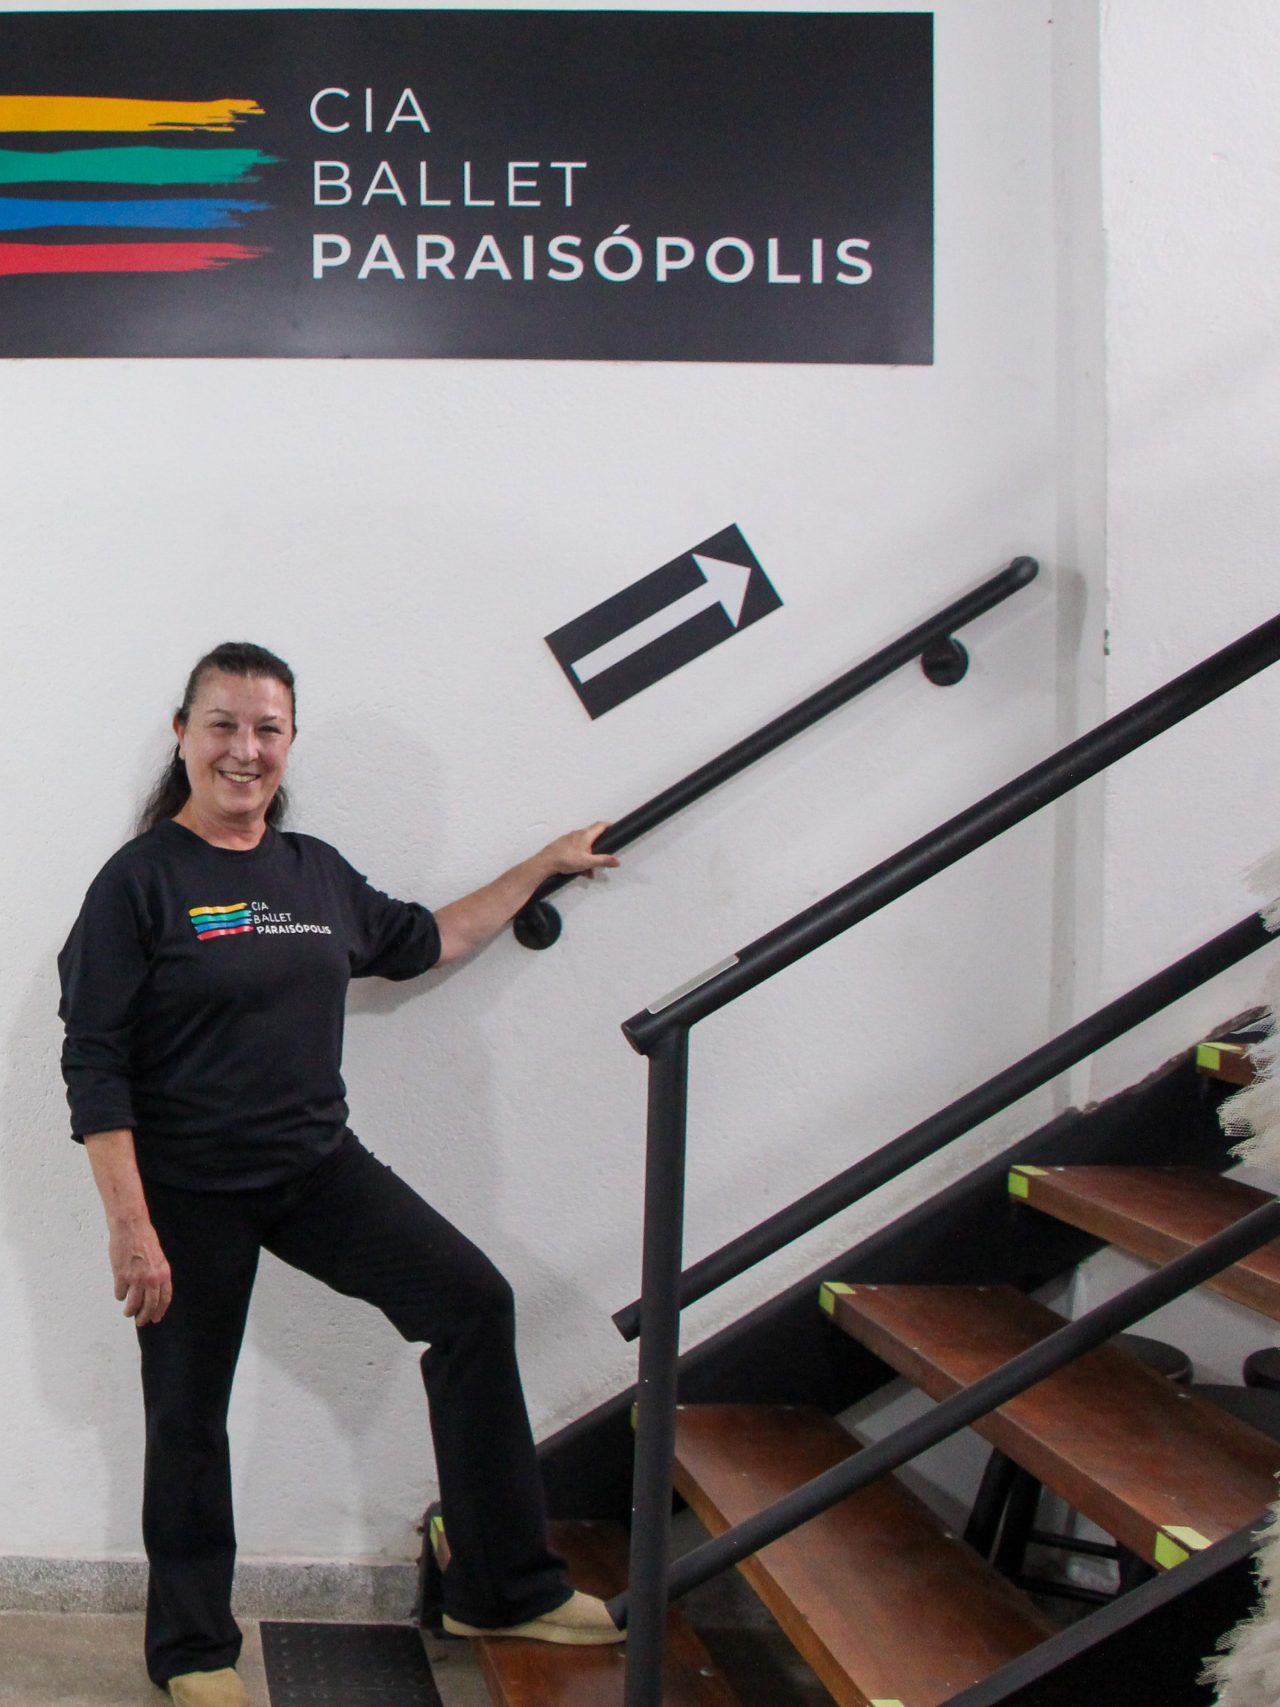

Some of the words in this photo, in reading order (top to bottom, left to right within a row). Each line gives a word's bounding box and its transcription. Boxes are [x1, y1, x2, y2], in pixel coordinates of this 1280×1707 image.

[309, 87, 431, 134] CIA
[312, 160, 588, 208] BALLET
[311, 224, 874, 286] PARAISÓPOLIS
[251, 901, 269, 912] CIA
[253, 912, 292, 925] BALLET
[256, 923, 332, 935] PARAISÓPOLIS
